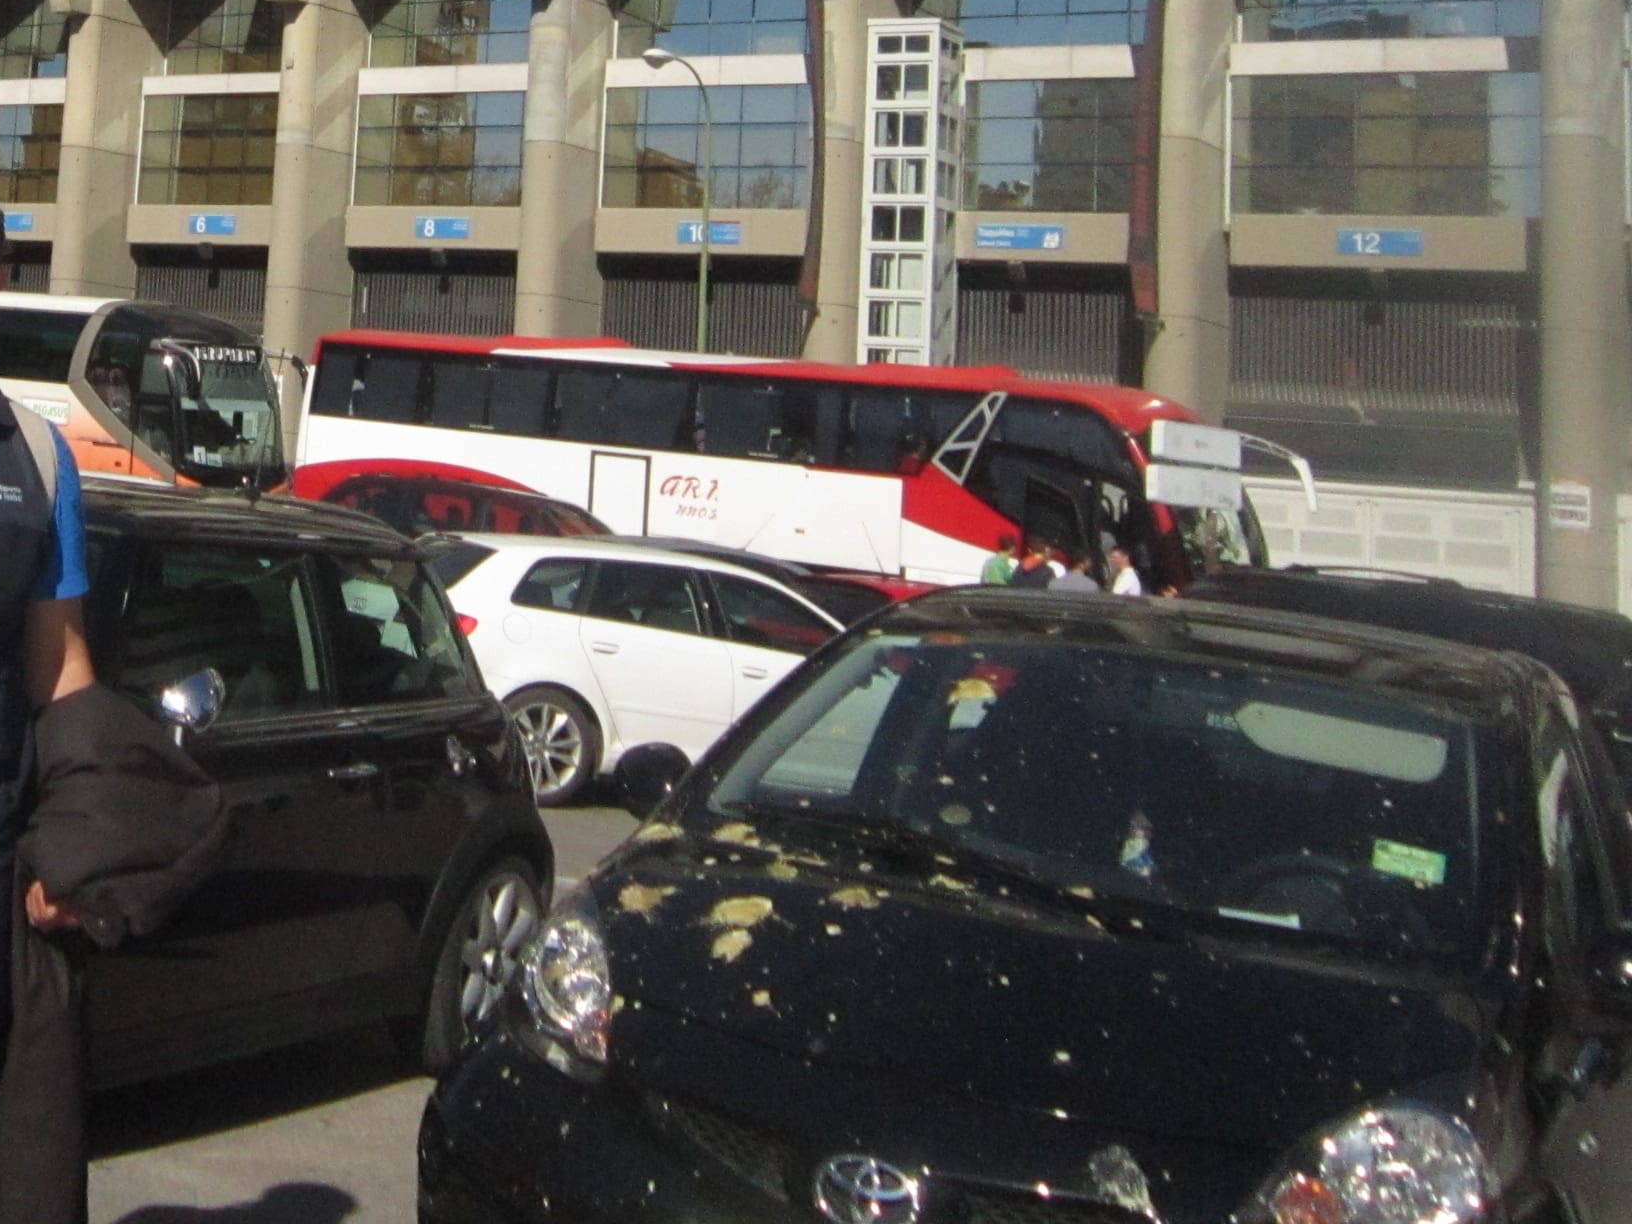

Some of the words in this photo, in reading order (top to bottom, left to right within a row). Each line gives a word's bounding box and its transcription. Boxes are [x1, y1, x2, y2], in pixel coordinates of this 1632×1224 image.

[196, 215, 206, 233] 6
[424, 219, 435, 237] 8
[1352, 232, 1380, 253] 12
